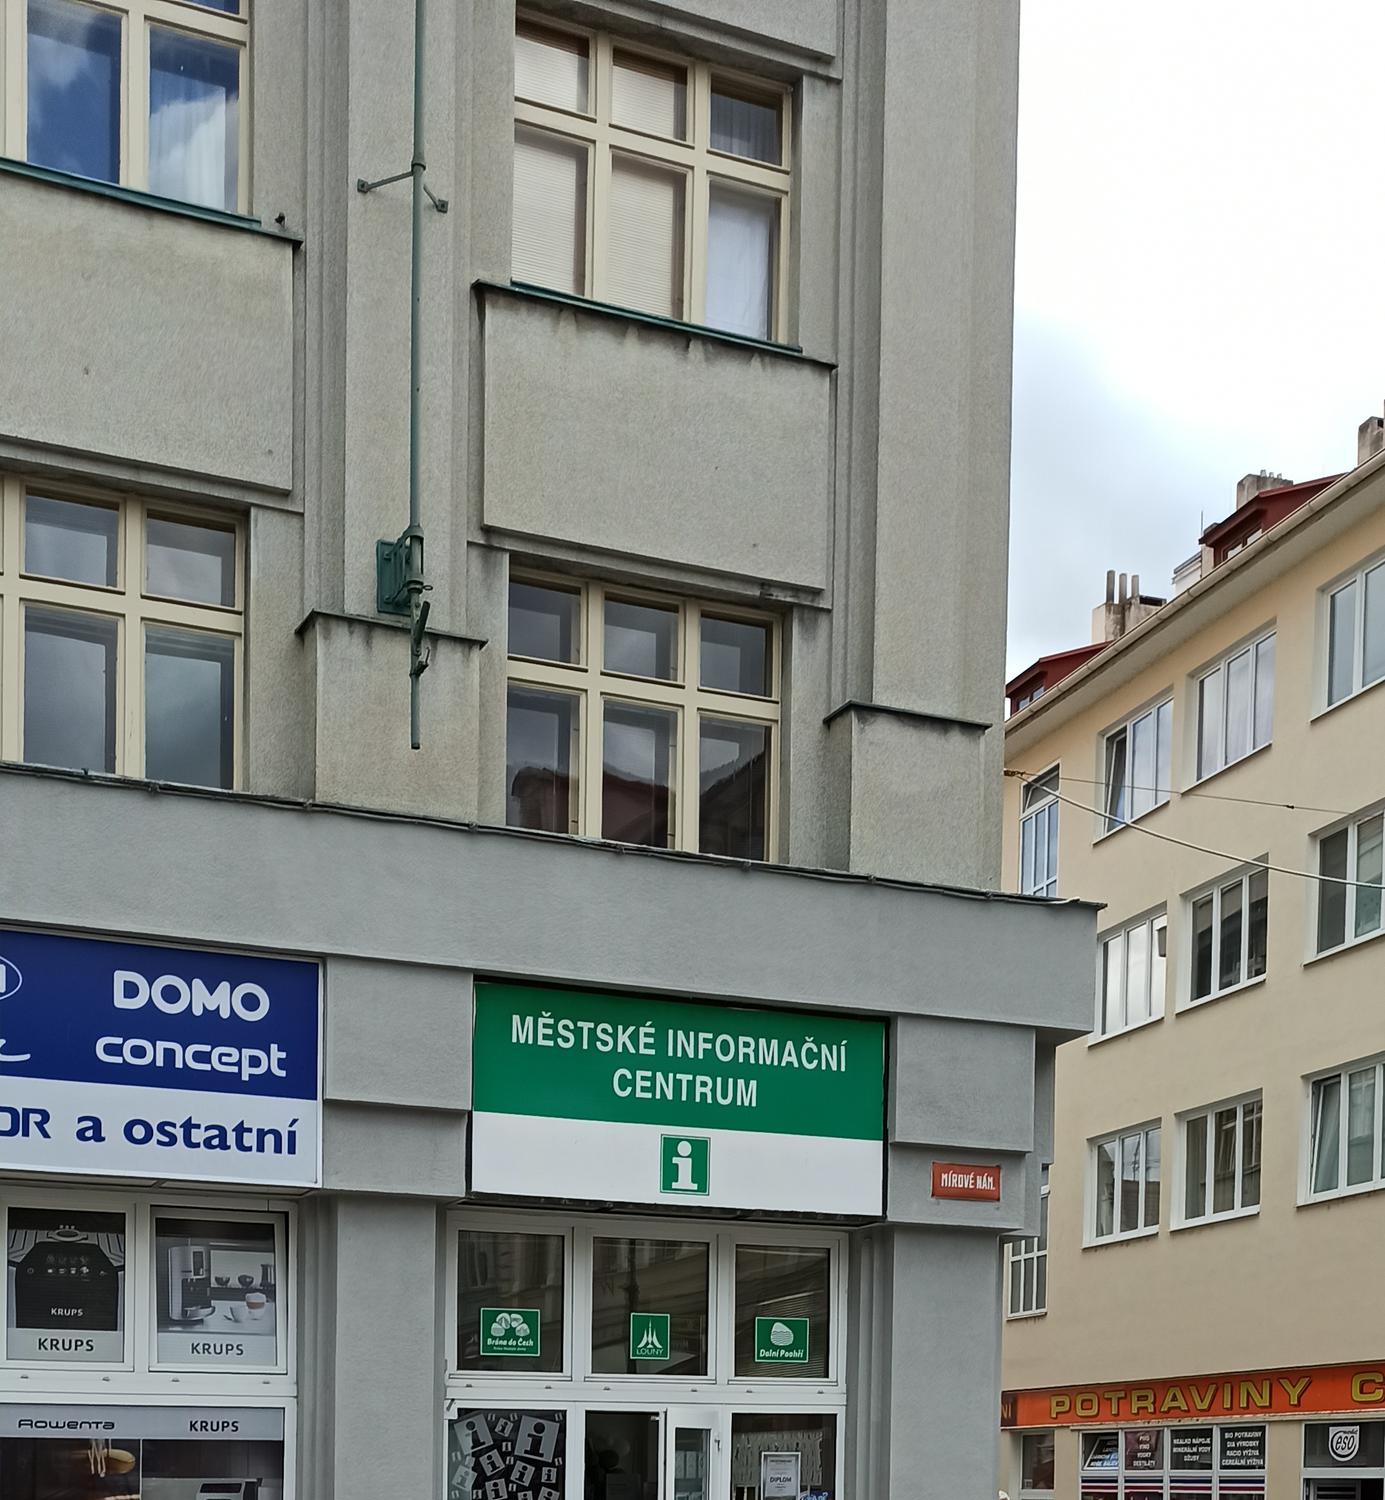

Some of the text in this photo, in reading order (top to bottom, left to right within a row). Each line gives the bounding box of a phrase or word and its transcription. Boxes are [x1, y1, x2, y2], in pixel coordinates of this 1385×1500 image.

[113, 969, 270, 1022] DOMO
[511, 1011, 848, 1072] MĚSTSKÉ INFORMAČNÍ
[95, 1036, 286, 1081] concept
[613, 1068, 758, 1108] CENTRUM
[75, 1115, 106, 1143] a
[123, 1116, 299, 1155] ostatní
[941, 1170, 975, 1188] MÍROVÉ
[50, 1307, 84, 1317] KRUPS
[38, 1337, 95, 1352] KRUPS
[191, 1342, 244, 1356] KRUPS
[636, 1348, 664, 1356] LOUNY
[1049, 1377, 1313, 1420] POTRAVINY
[189, 1420, 240, 1433] KRUPS
[1335, 1435, 1355, 1451] eso
